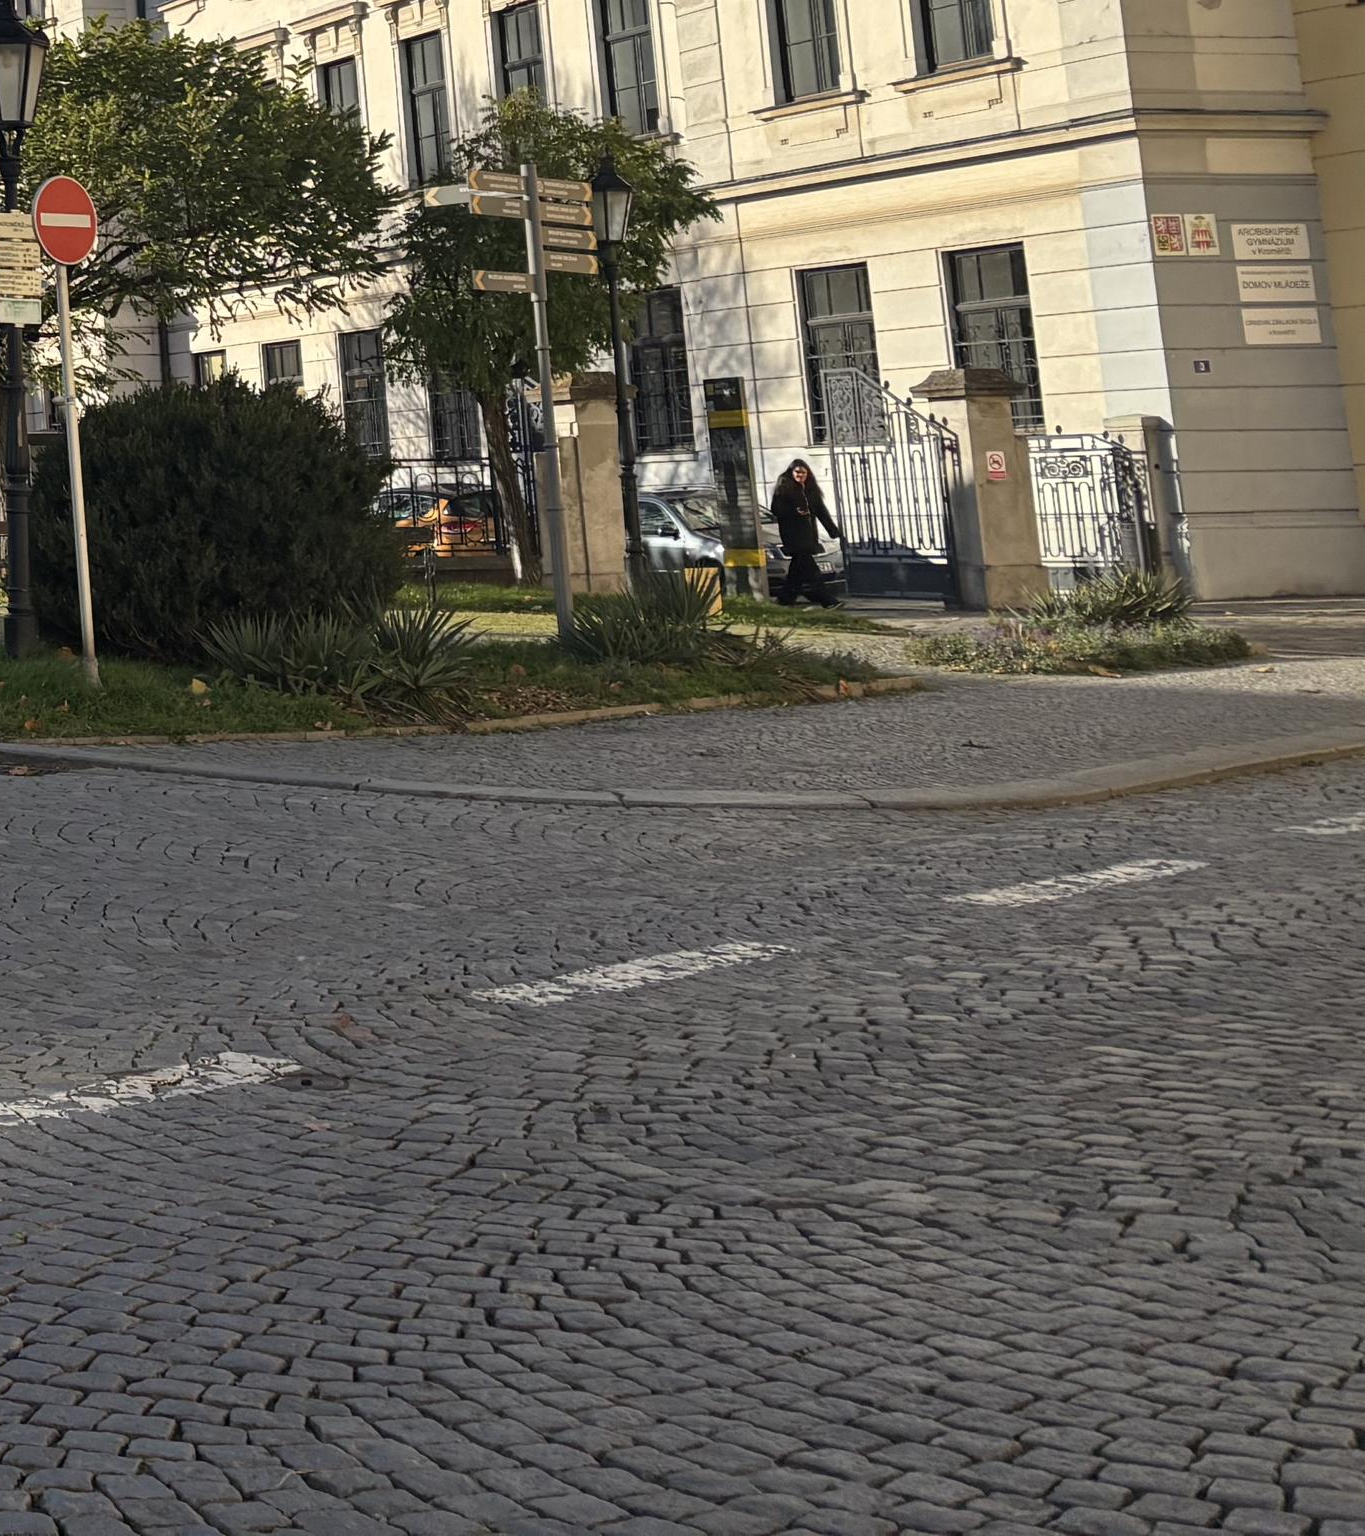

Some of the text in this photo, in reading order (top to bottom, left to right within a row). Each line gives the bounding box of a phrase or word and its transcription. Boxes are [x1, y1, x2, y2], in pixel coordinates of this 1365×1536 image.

[1245, 236, 1295, 246] GYMNÁZIUM
[1242, 278, 1311, 289] DOMOV MLÁDEŽE
